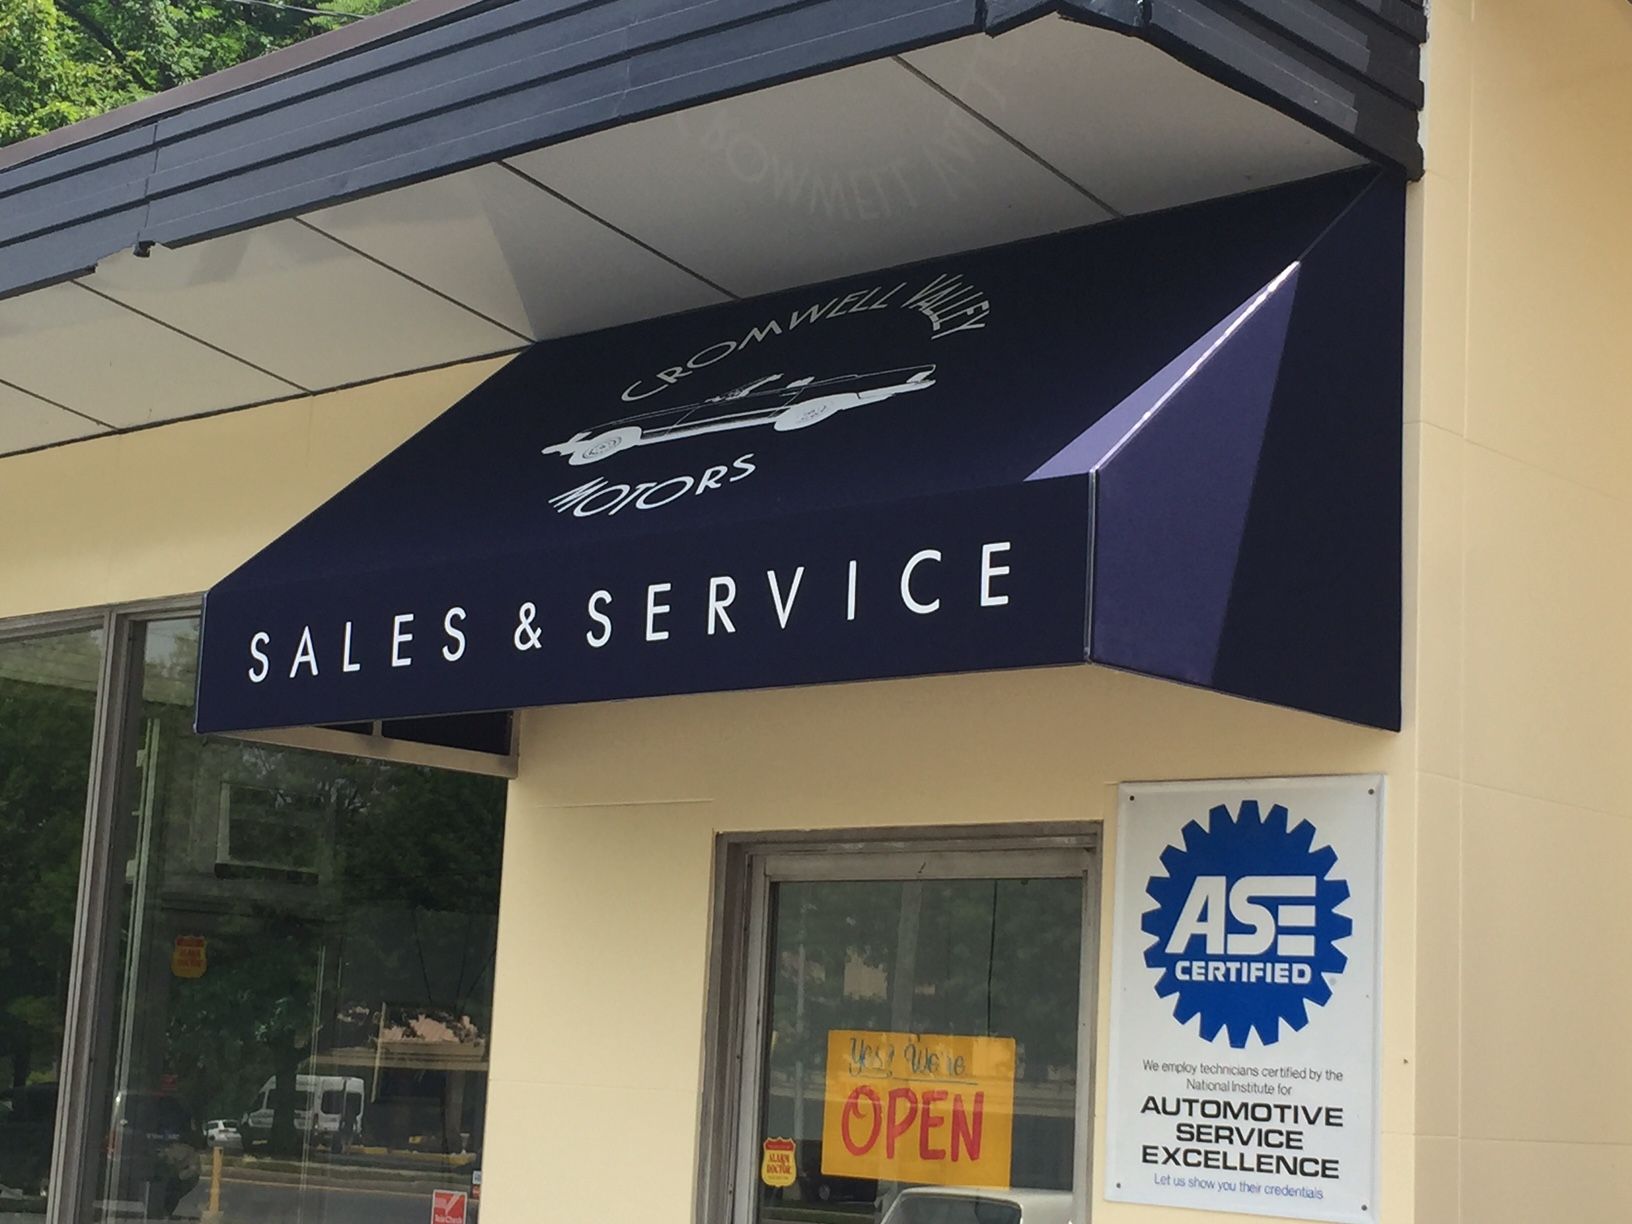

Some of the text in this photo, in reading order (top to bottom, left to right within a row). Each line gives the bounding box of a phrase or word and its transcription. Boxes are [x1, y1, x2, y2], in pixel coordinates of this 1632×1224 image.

[621, 273, 990, 402] CROMWELL VALLEY
[548, 453, 756, 517] MOTORS
[248, 541, 1012, 683] SALES & SERVICE
[1165, 875, 1317, 957] ASE
[1175, 960, 1312, 984] CERTIFIED
[1143, 1060, 1344, 1081] We employ technicians certified by the
[1186, 1078, 1293, 1096] National Institute for
[841, 1085, 985, 1162] OPEN
[1141, 1095, 1344, 1127] AUTOMOTIVE
[1176, 1123, 1304, 1150] SERVICE
[1142, 1145, 1340, 1179] EXCELLENCE
[1154, 1173, 1324, 1200] Let us show you their credentials
